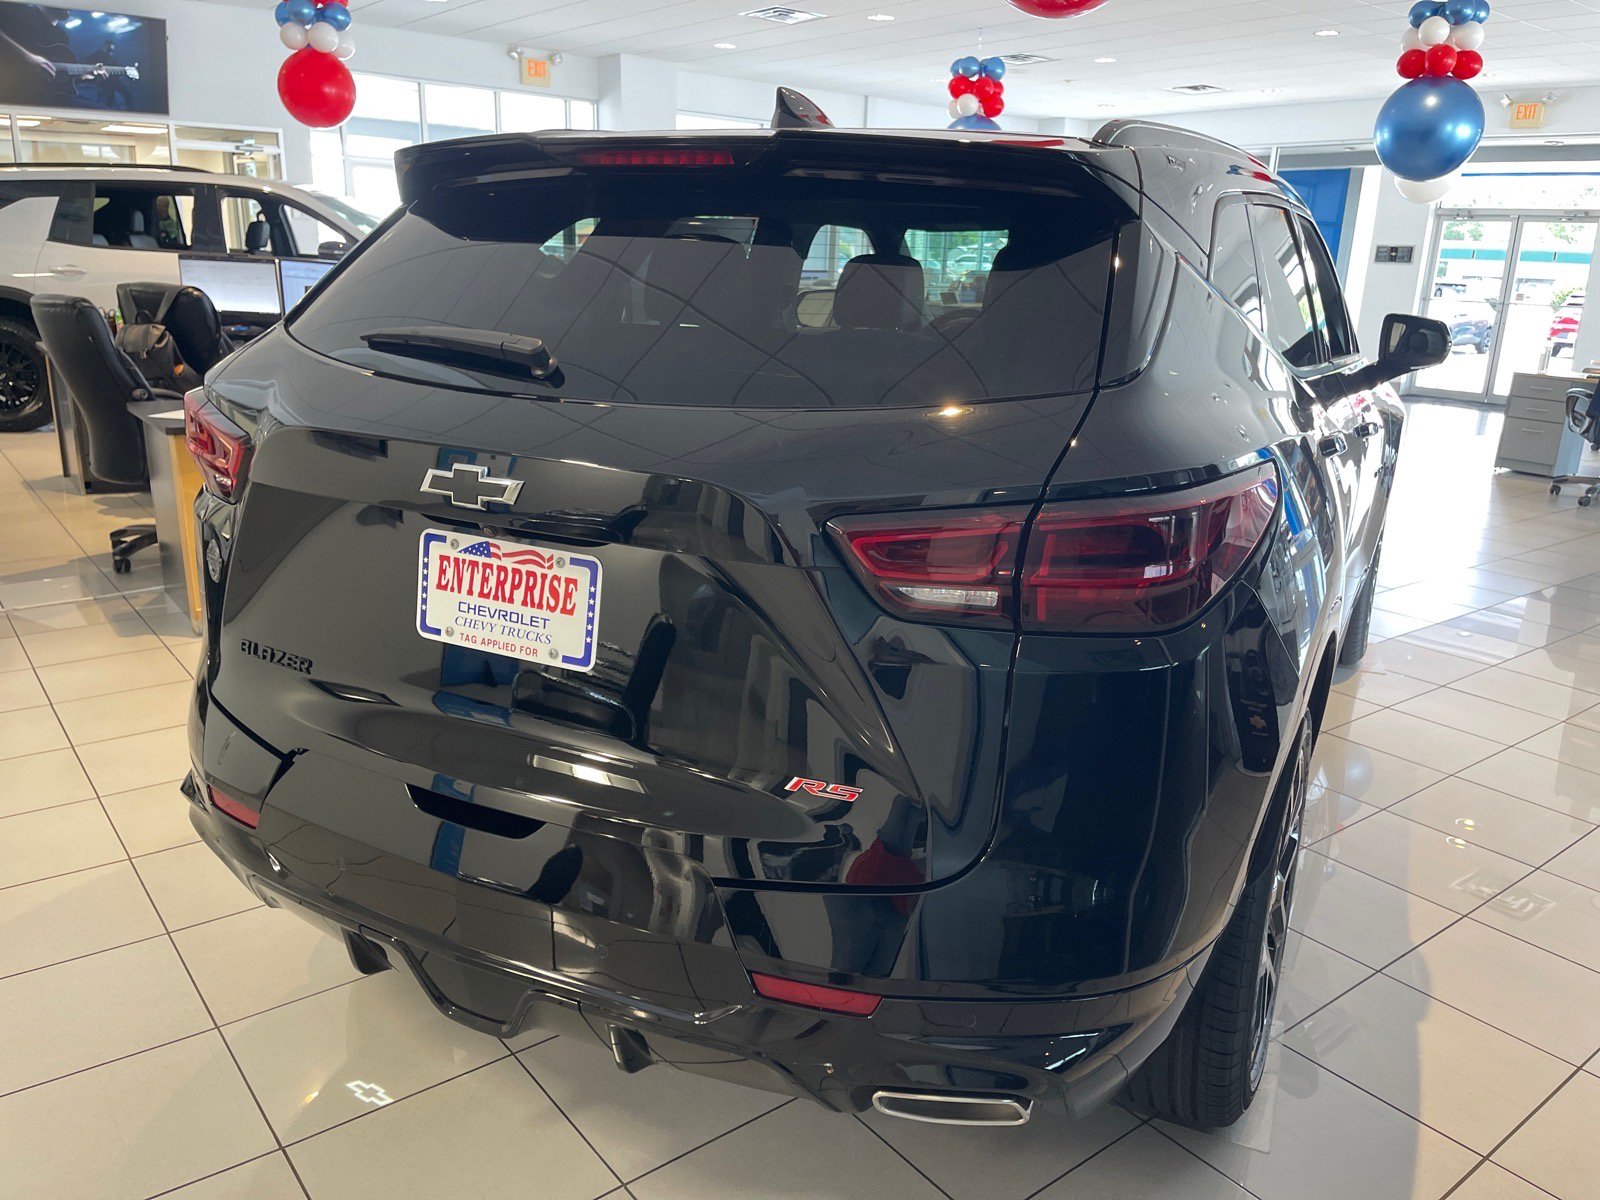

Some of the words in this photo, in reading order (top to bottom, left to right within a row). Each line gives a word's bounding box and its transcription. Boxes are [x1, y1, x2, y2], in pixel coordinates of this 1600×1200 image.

[1516, 103, 1538, 120] EXIT
[435, 554, 578, 617] ENTERPRISE
[454, 615, 497, 633] CHEVY
[499, 624, 552, 645] TRUCKS
[458, 601, 550, 630] CHEVROLET
[240, 638, 314, 675] BLAZER
[459, 632, 477, 644] TAG
[480, 637, 517, 653] APPLIED
[519, 645, 539, 658] FOR
[783, 776, 864, 802] RS
